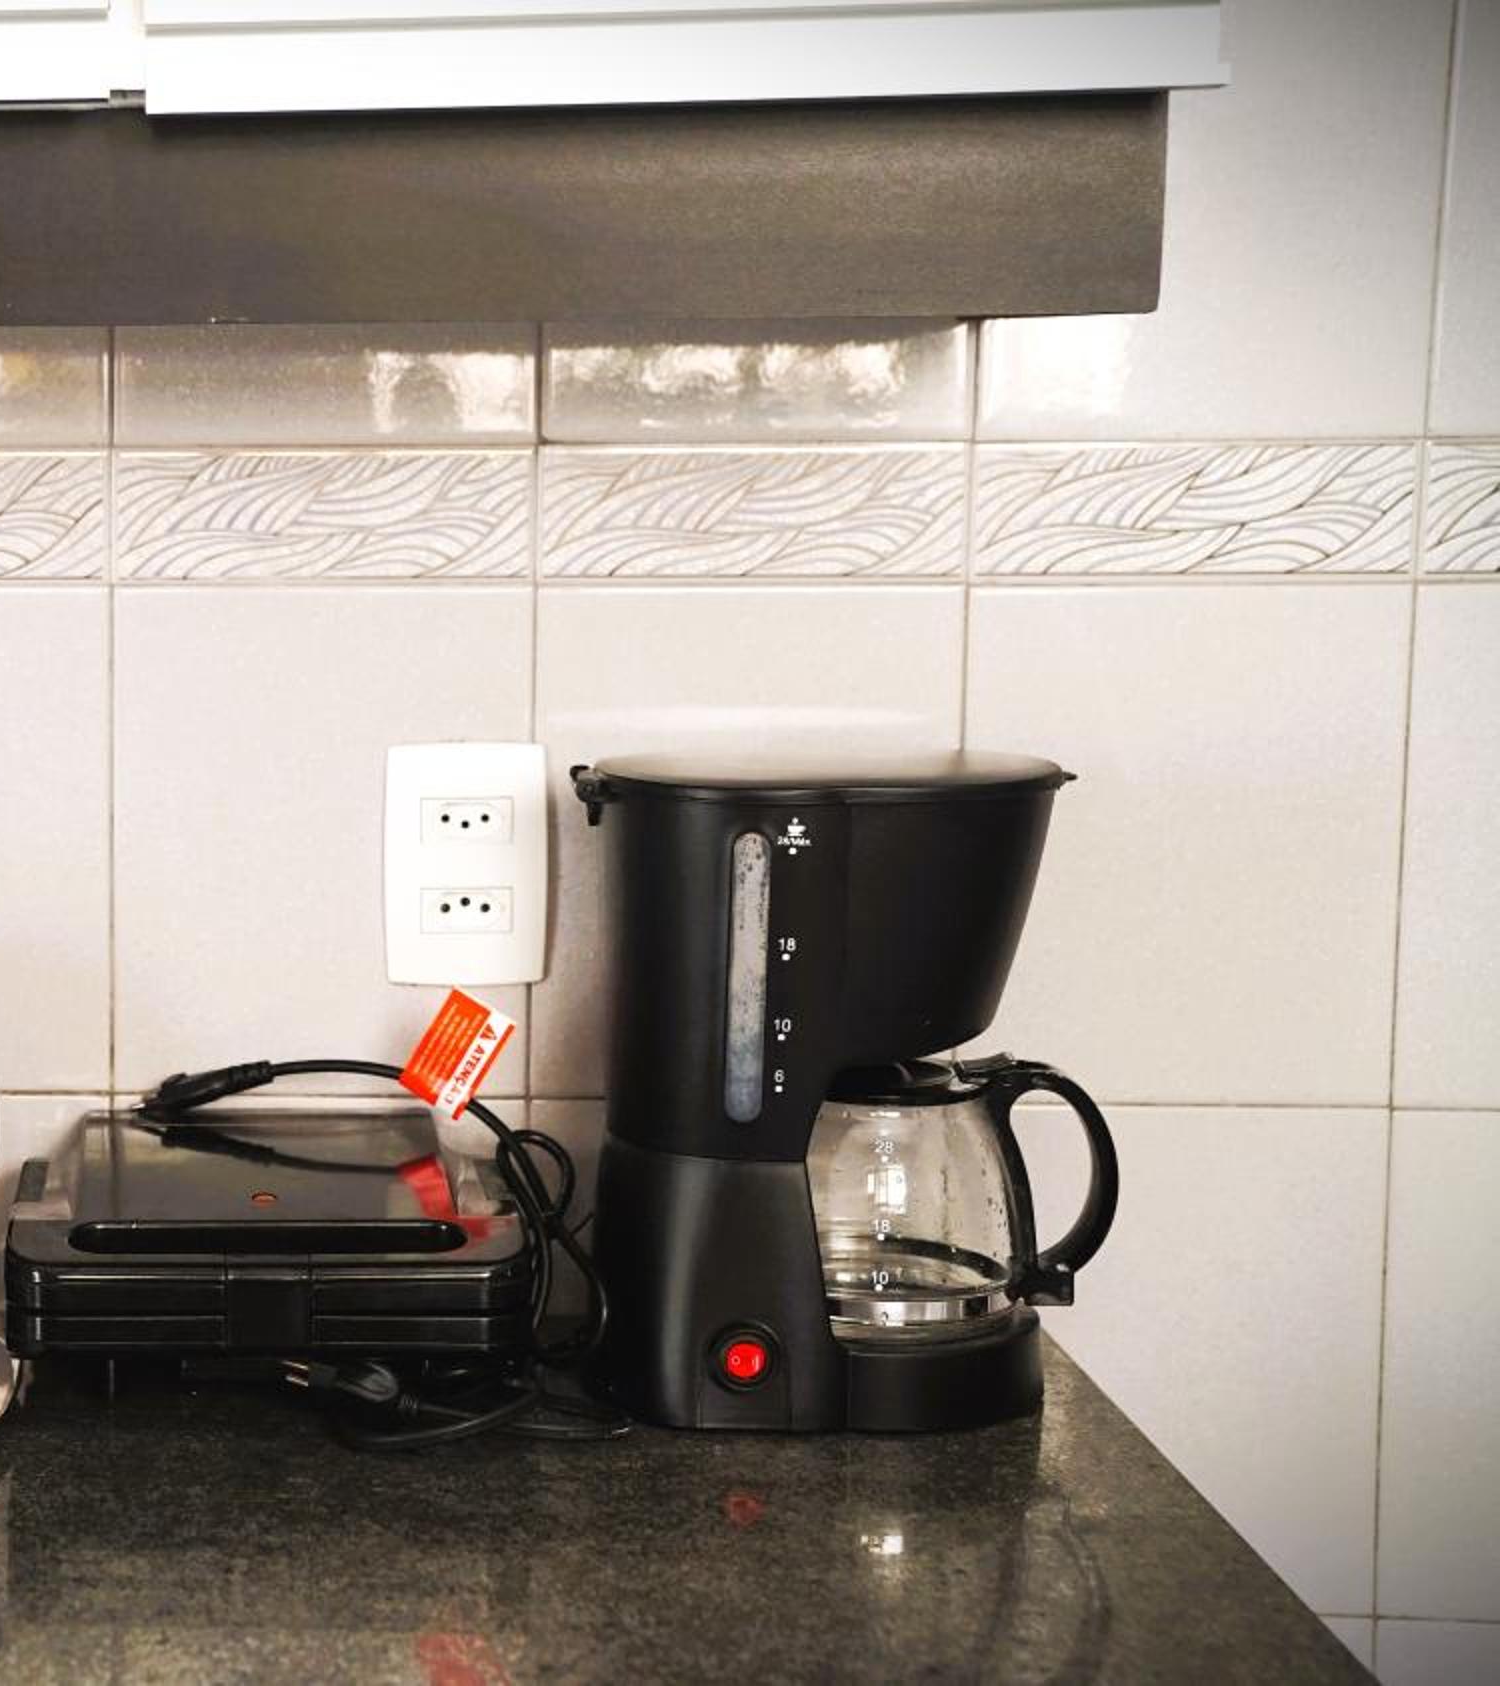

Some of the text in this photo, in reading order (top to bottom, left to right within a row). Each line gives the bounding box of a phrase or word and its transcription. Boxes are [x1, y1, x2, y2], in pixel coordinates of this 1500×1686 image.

[777, 937, 797, 952] 18
[773, 1019, 792, 1034] 10
[774, 1069, 785, 1083] 6
[874, 1140, 894, 1154] 28
[873, 1219, 891, 1234] 18
[871, 1271, 889, 1286] 10
